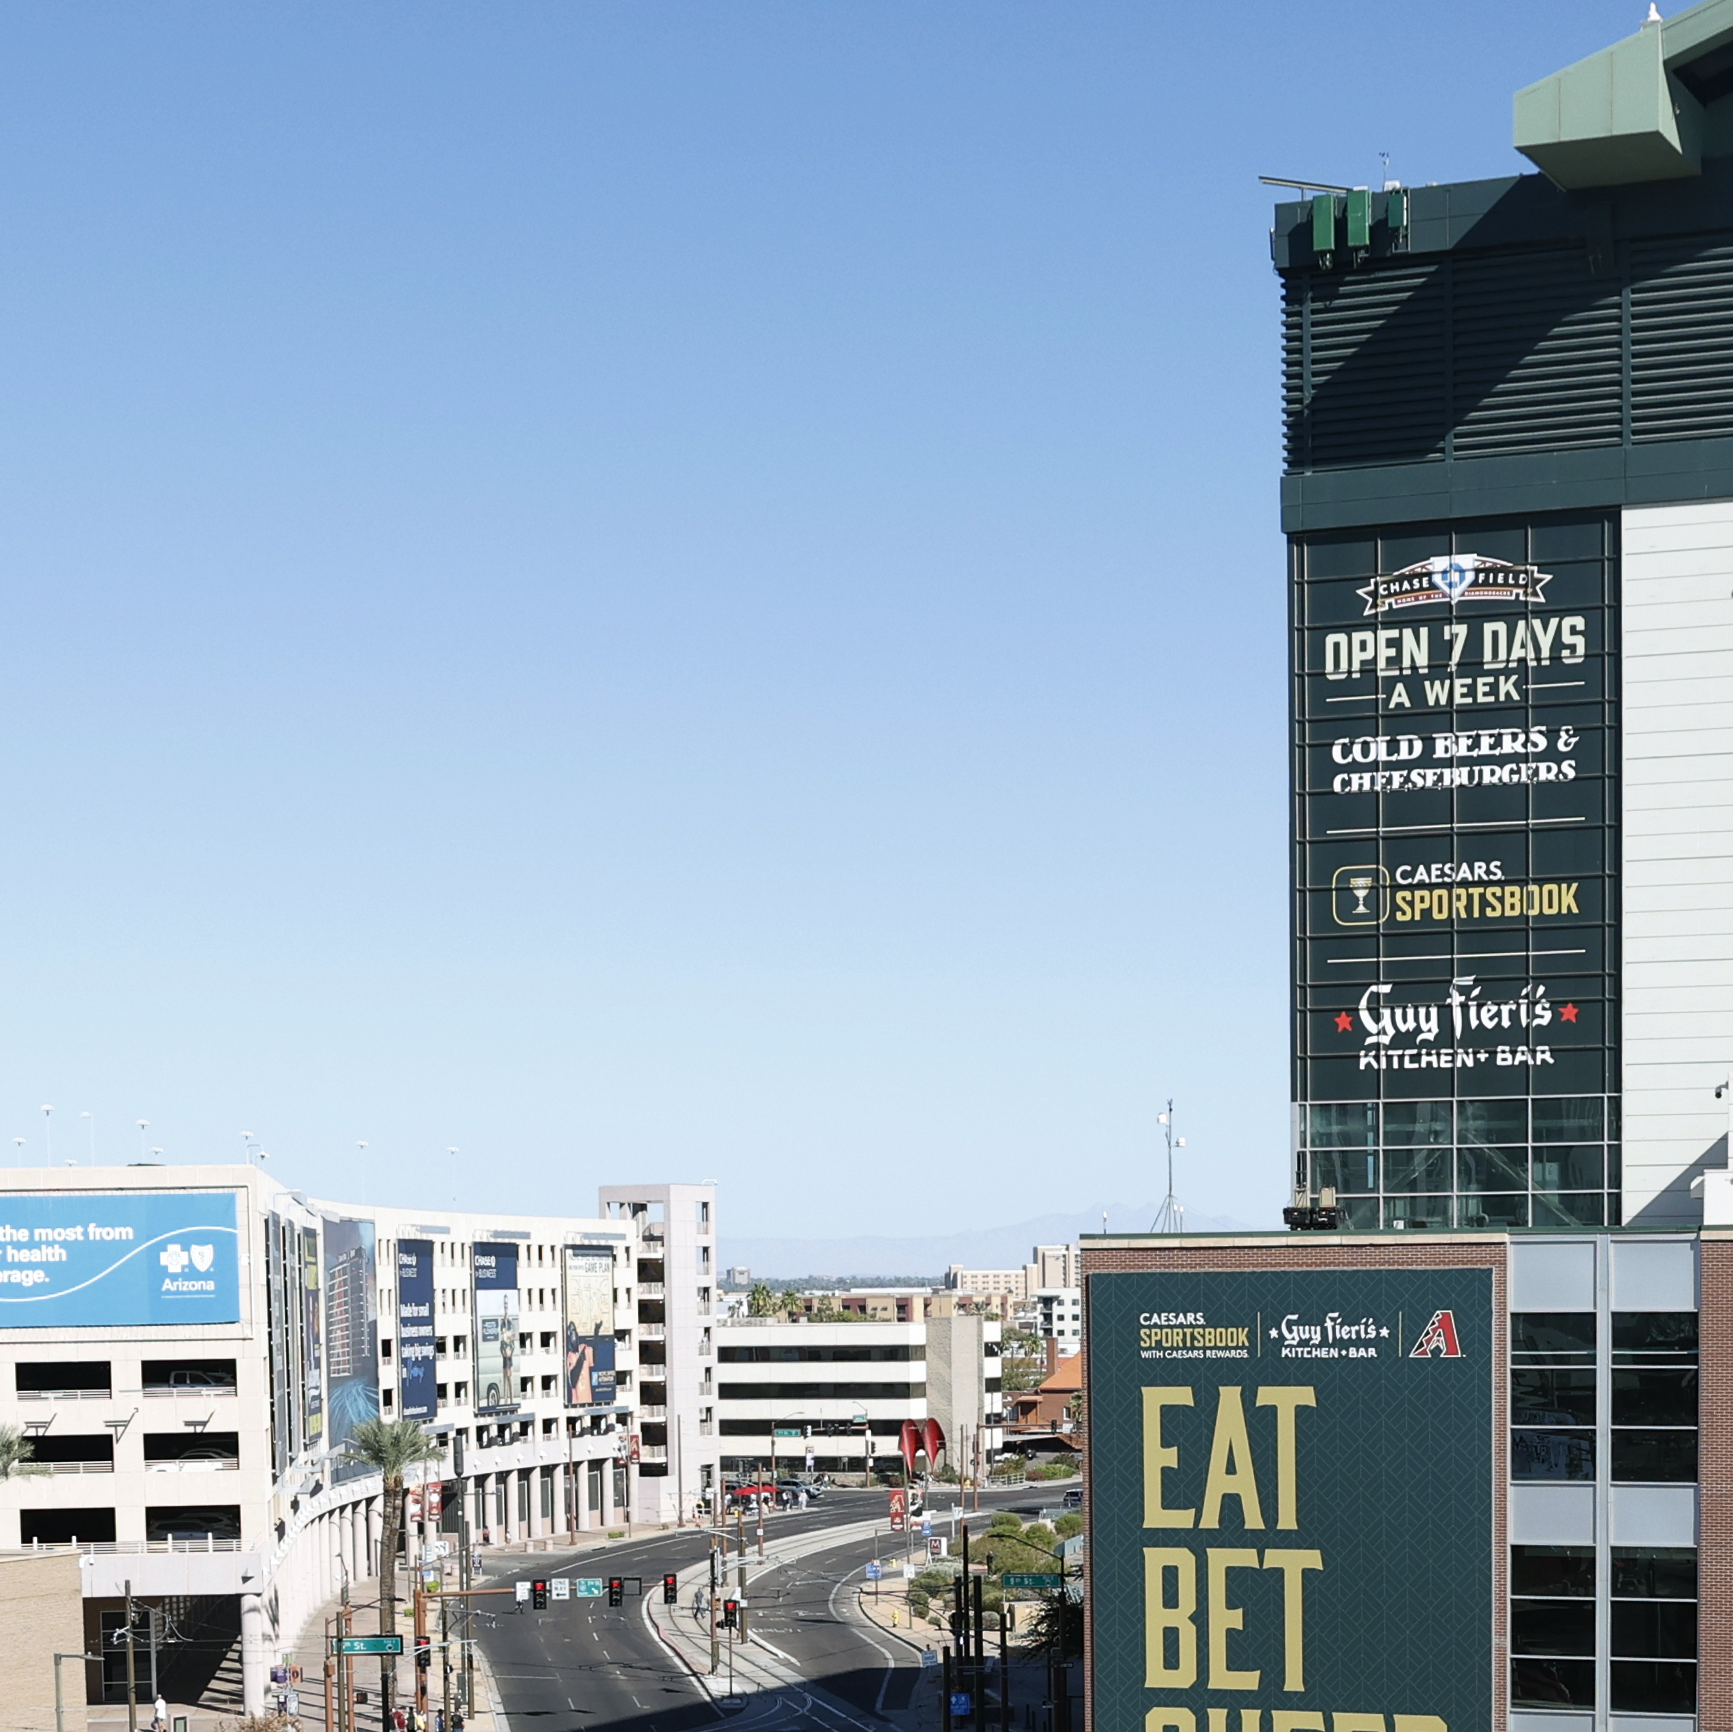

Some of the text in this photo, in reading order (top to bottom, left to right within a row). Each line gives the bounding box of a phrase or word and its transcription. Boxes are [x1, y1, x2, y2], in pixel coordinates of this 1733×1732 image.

[1378, 572, 1528, 596] CHASE FIELD
[1325, 615, 1586, 681] OPEN 7 DAYS
[1388, 674, 1521, 709] A WEEK
[1331, 725, 1580, 765] COLD BEERS &
[1331, 760, 1577, 794] CHEESEBURGERS
[1395, 883, 1580, 922] SPORTSBOOK
[1358, 984, 1441, 1046] Guy
[1358, 1048, 1474, 1071] KITCHEN
[1496, 1045, 1555, 1067] BAR
[34, 1224, 85, 1242] most
[87, 1222, 134, 1241] from
[6, 1244, 67, 1262] health
[161, 1277, 215, 1292] Arizona
[1139, 1327, 1250, 1348] SPORTSBOOK
[1280, 1313, 1322, 1346] Guy
[1140, 1350, 1164, 1359] WITH
[1165, 1350, 1205, 1359] CAESARS
[1281, 1347, 1378, 1359] KITCHEN BAR
[1140, 1385, 1318, 1531] EAT
[1142, 1546, 1324, 1693] BET
